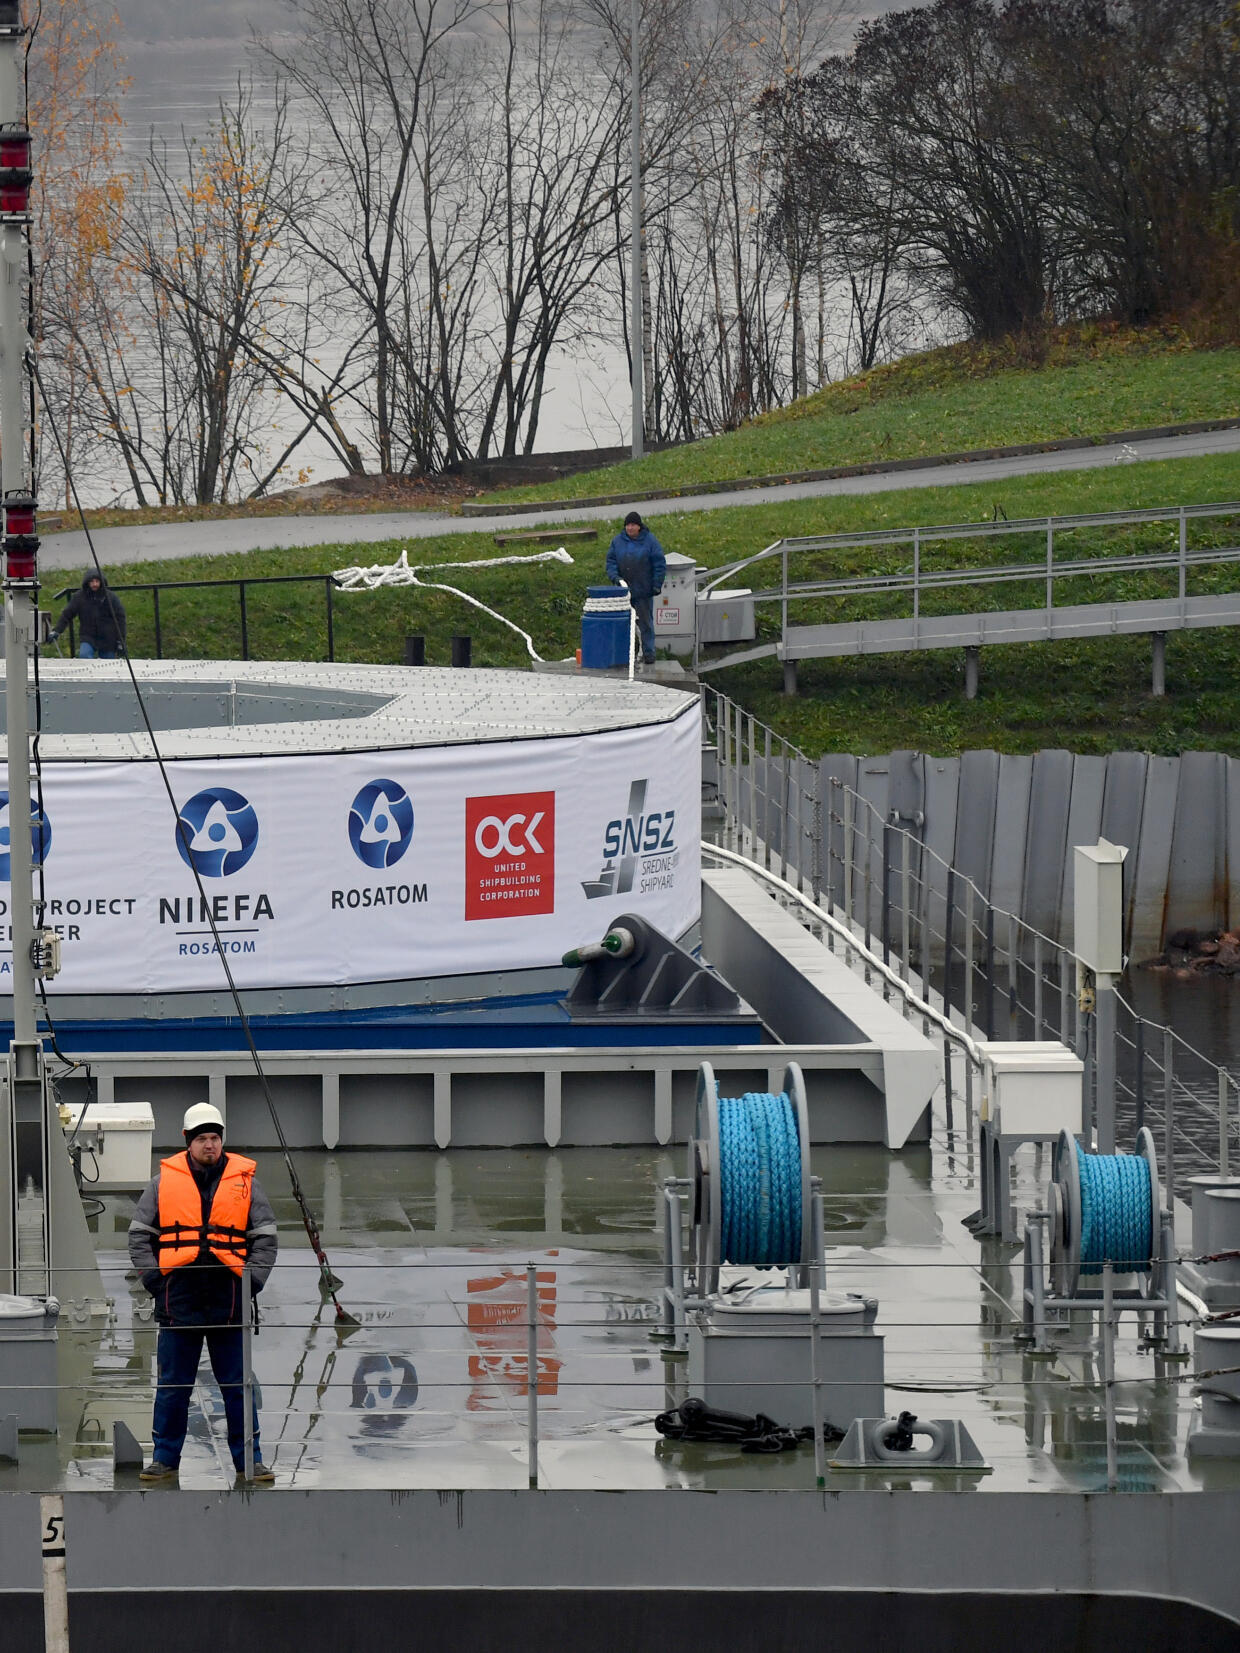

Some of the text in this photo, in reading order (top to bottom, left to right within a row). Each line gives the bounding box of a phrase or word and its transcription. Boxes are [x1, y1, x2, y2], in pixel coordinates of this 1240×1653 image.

[603, 810, 675, 859] SNSZ
[494, 862, 526, 873] UNITED
[480, 874, 541, 888] SHIPBUILDING
[331, 883, 429, 909] ROSATOM
[480, 888, 540, 902] CORPORATION
[158, 894, 275, 924] NIIEFA
[178, 940, 256, 956] ROSATOM
